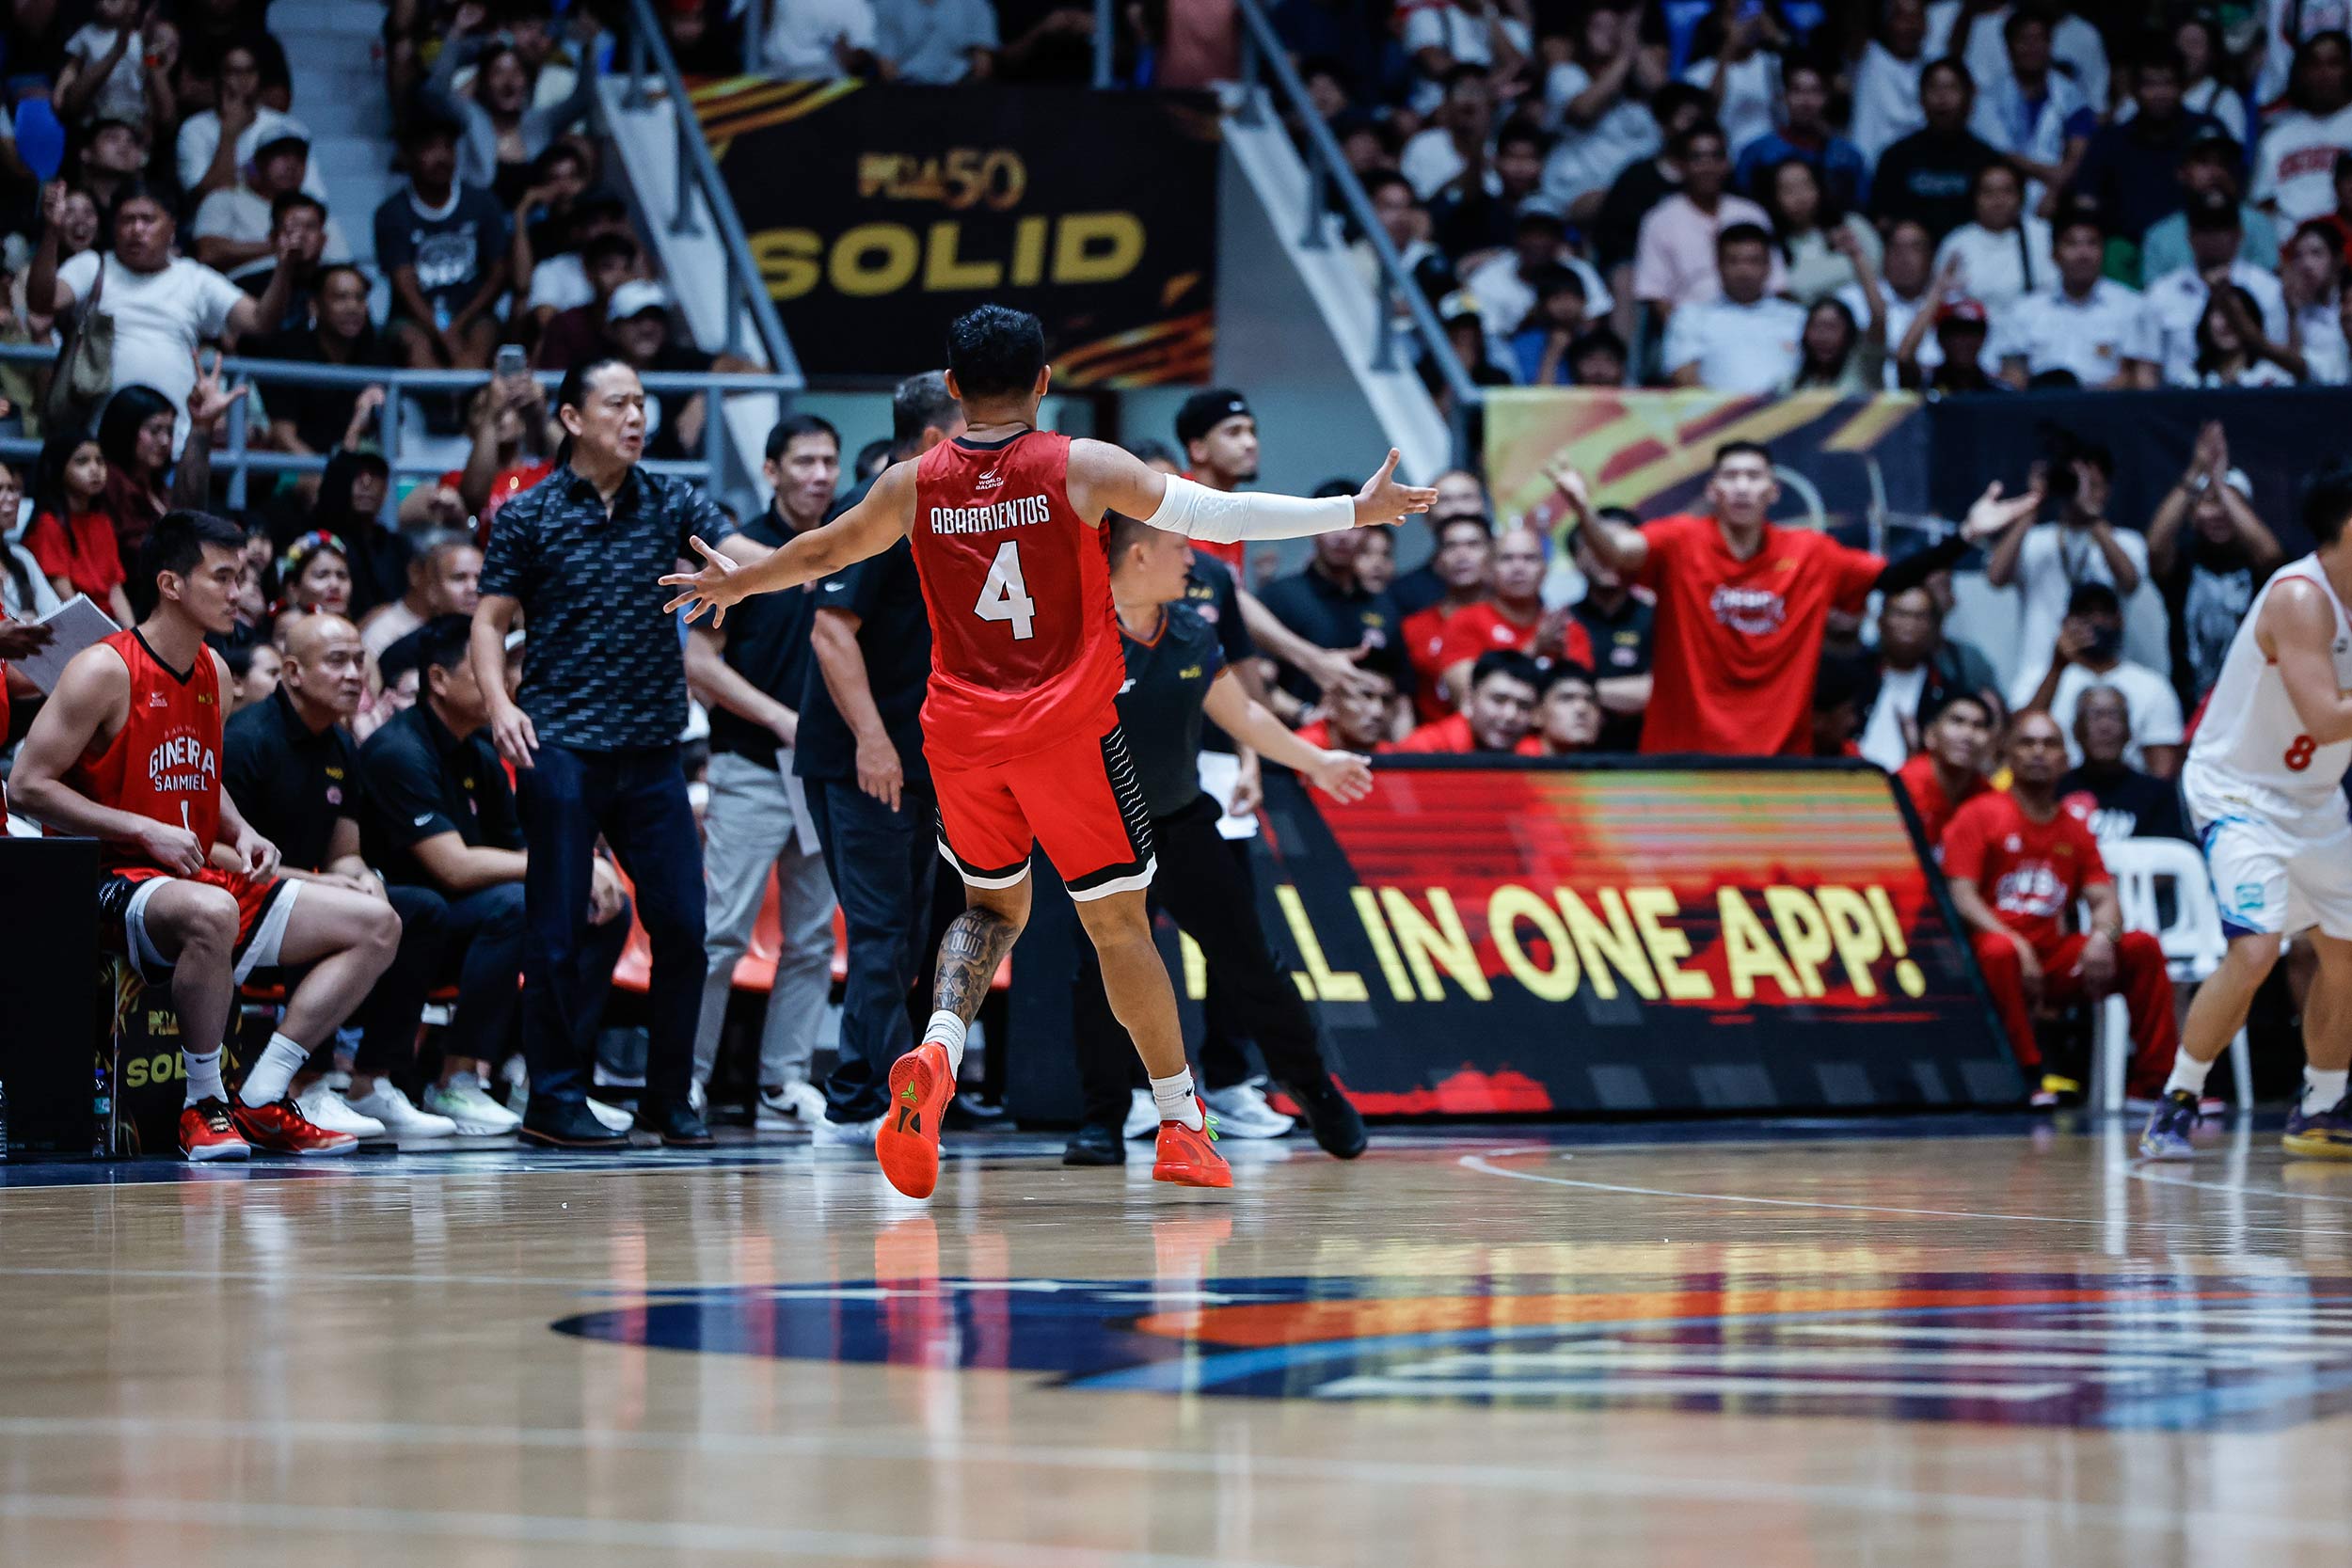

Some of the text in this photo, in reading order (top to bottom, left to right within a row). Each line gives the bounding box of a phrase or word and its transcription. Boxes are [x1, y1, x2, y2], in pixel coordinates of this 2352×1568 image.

[749, 212, 1146, 301] SOLID
[975, 481, 1005, 491] BALANCE
[978, 476, 1002, 486] WORLD
[930, 494, 1051, 535] ABARRIENTOS
[973, 539, 1036, 641] 4
[2284, 735, 2317, 771] 8
[1350, 886, 1493, 1002] IN
[1488, 884, 1714, 1002] ONE
[1717, 884, 1926, 1000] APP!
[126, 1044, 230, 1088] SOL
